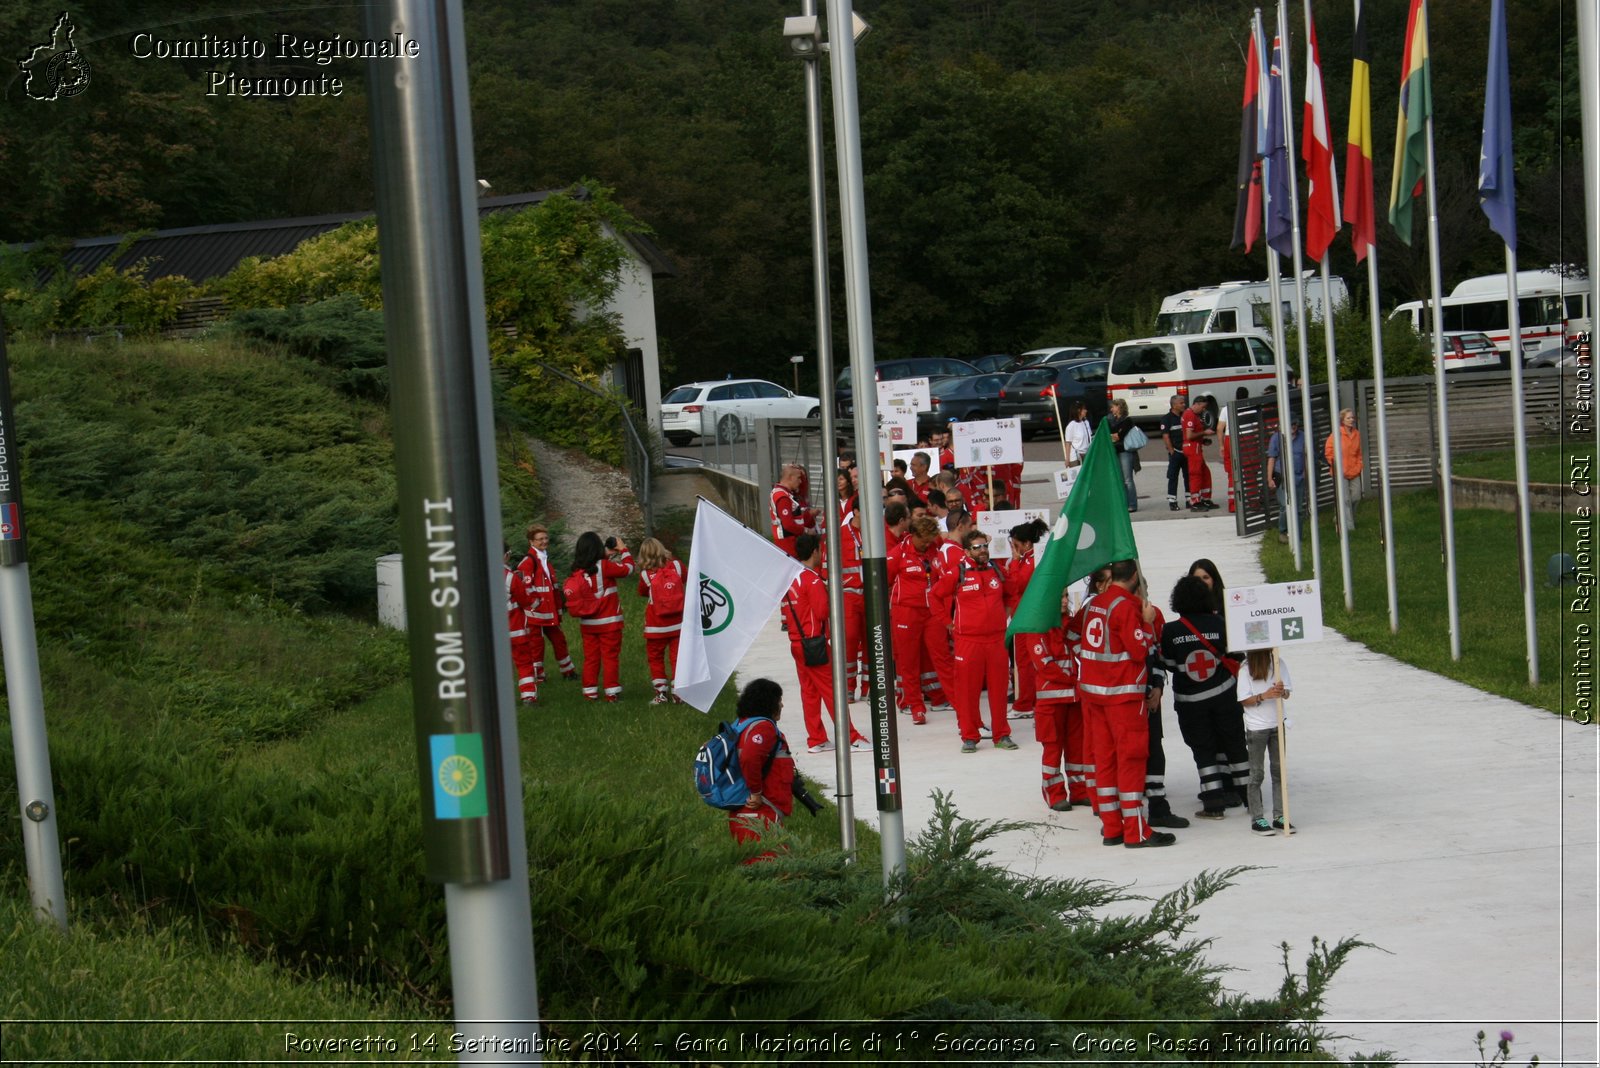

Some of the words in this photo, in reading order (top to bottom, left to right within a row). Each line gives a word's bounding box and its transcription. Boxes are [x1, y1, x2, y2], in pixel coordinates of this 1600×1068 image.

[424, 497, 467, 700] ROM-SINTI
[1250, 606, 1296, 617] LOMBARDIA
[873, 624, 886, 690] DOMINICANA
[878, 694, 890, 760] REPUBBLICA
